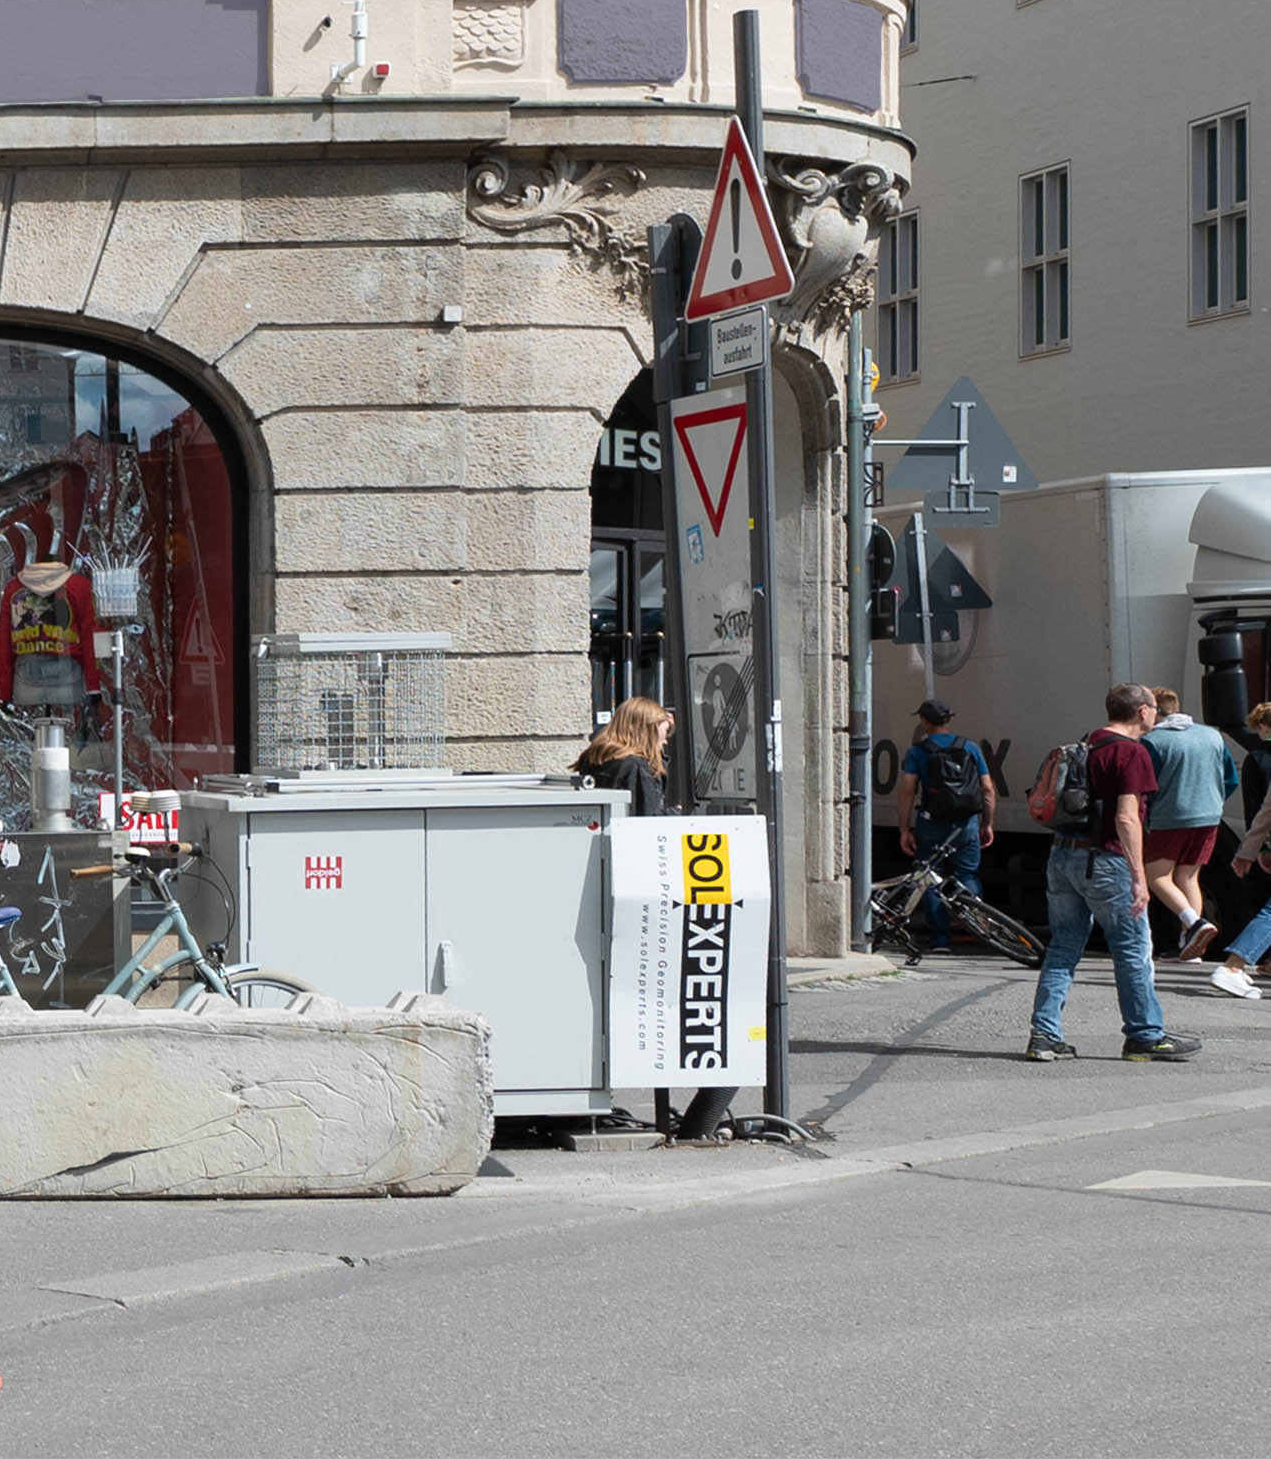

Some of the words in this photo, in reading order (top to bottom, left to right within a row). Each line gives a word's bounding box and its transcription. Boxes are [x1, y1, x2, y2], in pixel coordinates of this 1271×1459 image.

[657, 835, 668, 877] Swiss
[658, 884, 670, 954] Precision
[684, 834, 725, 1070] SOLEXPERTS
[637, 904, 650, 1051] www.solexperts.com
[654, 960, 669, 1071] Geomonitoring
